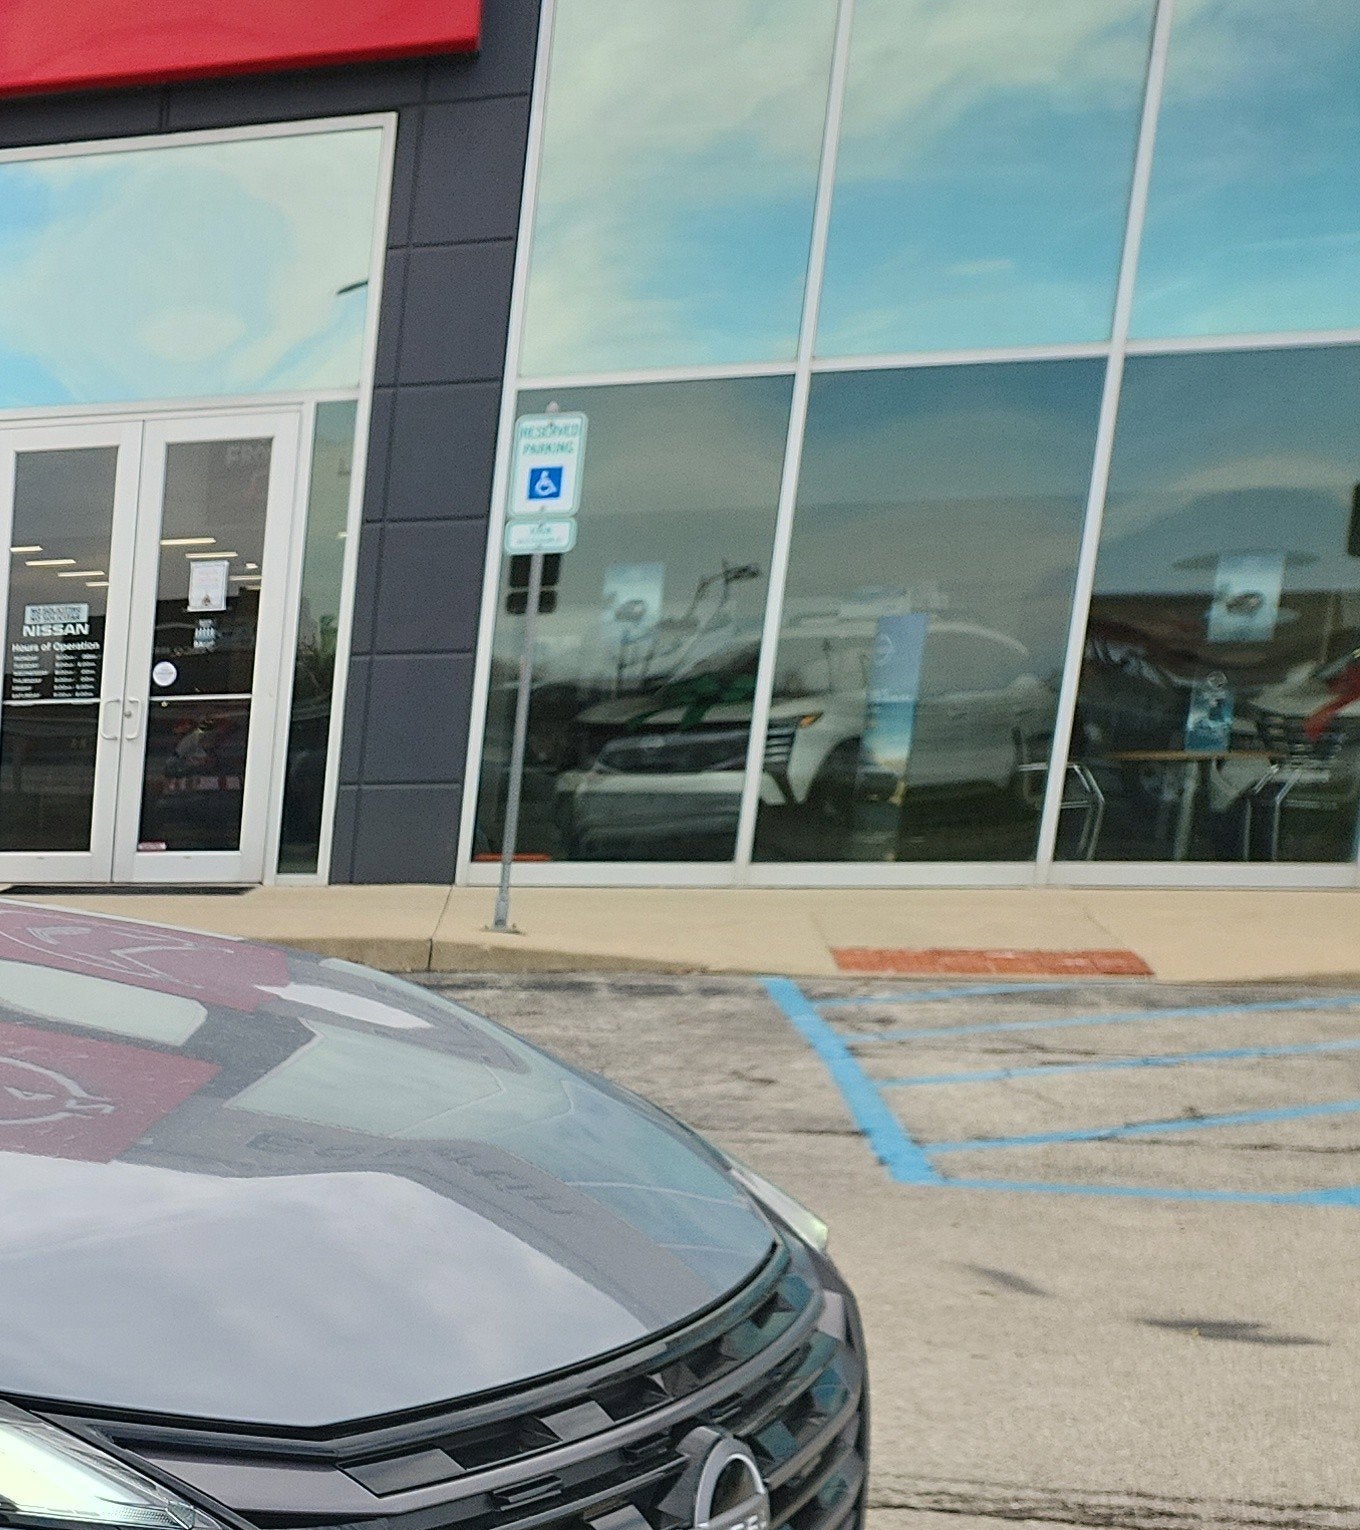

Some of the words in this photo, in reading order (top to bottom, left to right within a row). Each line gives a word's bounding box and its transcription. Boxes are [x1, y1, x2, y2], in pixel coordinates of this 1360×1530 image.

[519, 423, 579, 438] RESERVED
[522, 441, 575, 455] PARKING
[22, 623, 90, 637] NISSAN
[11, 643, 40, 652] Hours
[40, 641, 52, 652] of
[52, 640, 100, 652] Operation
